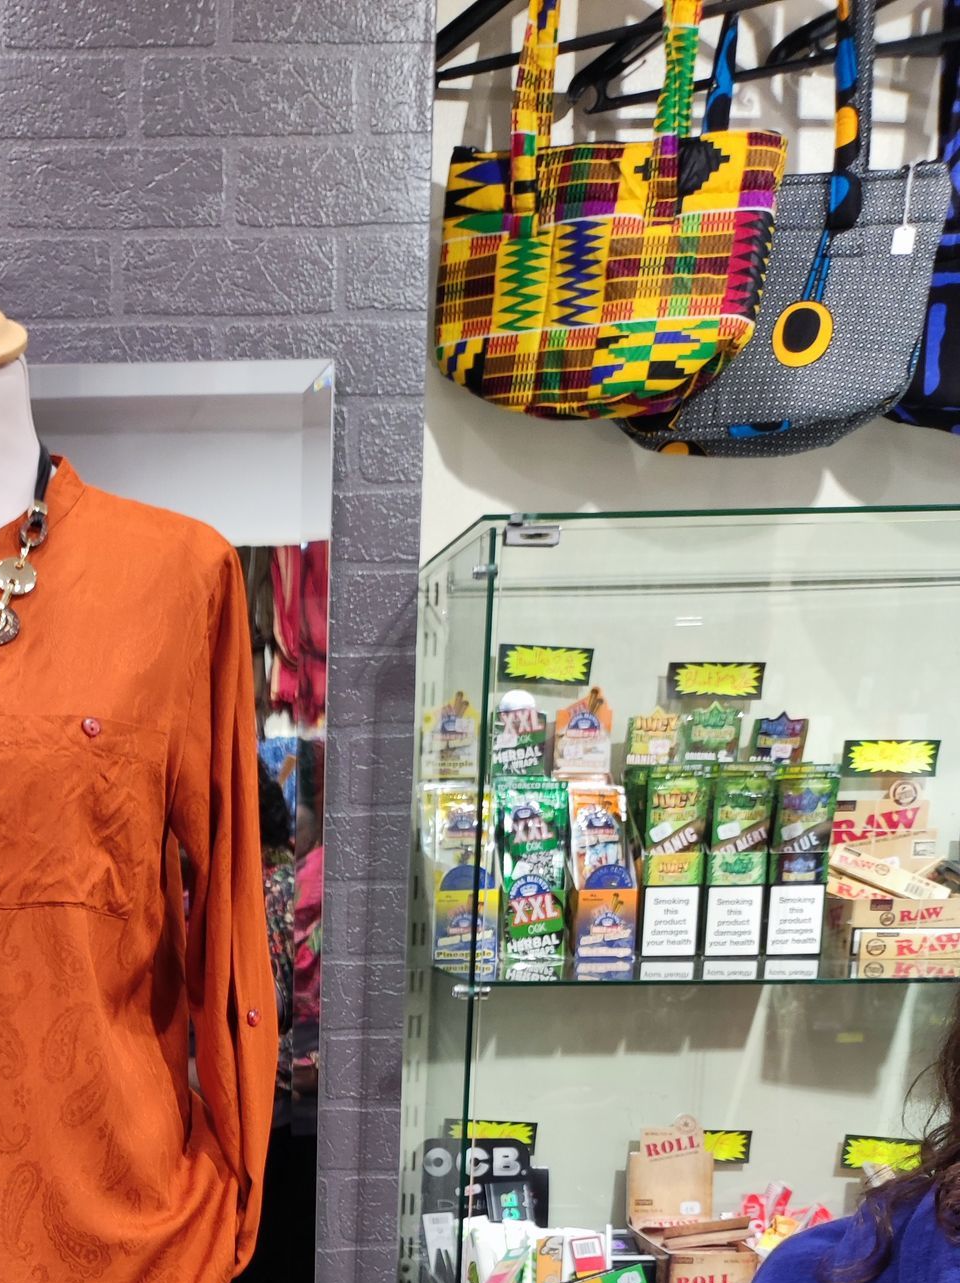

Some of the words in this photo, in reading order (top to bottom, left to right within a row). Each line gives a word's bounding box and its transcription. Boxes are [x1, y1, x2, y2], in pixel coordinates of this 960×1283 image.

[501, 708, 544, 736] XXL
[493, 746, 542, 763] HERBAL
[513, 817, 553, 843] XXL
[832, 807, 920, 845] RAW
[512, 894, 559, 925] XXL
[717, 898, 752, 906] Smoking
[717, 919, 749, 927] product
[780, 917, 811, 925] product
[900, 907, 943, 922] RAW
[714, 929, 751, 937] damages
[776, 928, 813, 936] damages
[507, 933, 560, 953] HERBAL
[645, 1135, 700, 1157] ROLL
